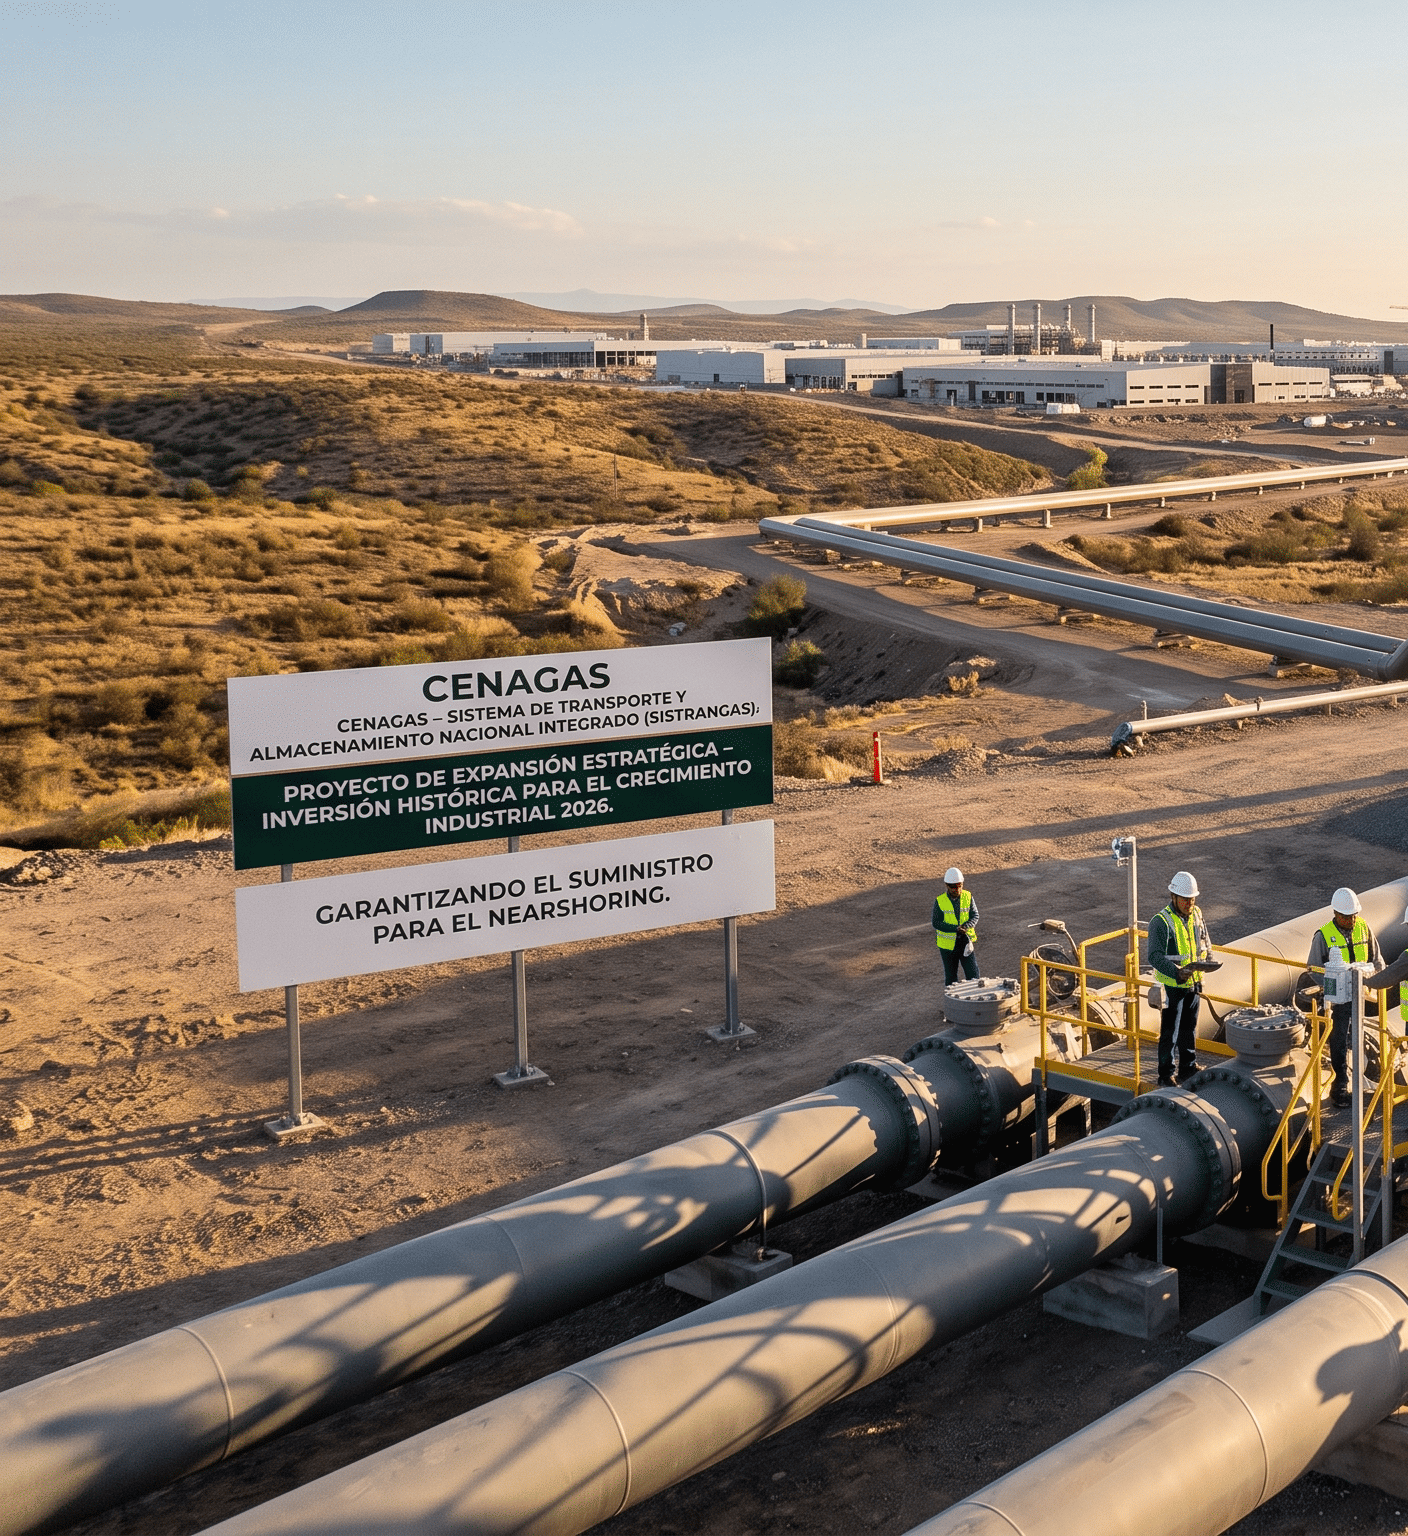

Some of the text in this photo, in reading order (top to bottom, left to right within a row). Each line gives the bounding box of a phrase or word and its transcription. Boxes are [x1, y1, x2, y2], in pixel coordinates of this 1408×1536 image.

[422, 662, 611, 703] CENAGAS
[249, 732, 435, 762] ALMACENAMIENTO
[439, 722, 535, 745] NACIONAL
[538, 712, 640, 735] INTEGRADO
[337, 712, 429, 733] CENAGAS
[447, 704, 526, 724] SISTEMA
[530, 701, 554, 716] DE
[557, 691, 672, 714] TRANSPORTE
[675, 690, 687, 703] Y
[262, 759, 752, 830] INVERSIÓN HISTÓRICA PARA EL CRECIMIENTO
[284, 774, 409, 803] PROYECTO
[415, 769, 447, 789] DE
[452, 753, 576, 785] EXPANSIÓN
[582, 741, 719, 771] ESTRATÉGICA
[425, 797, 614, 835] INDUSTRIAL 2026.
[315, 853, 714, 925] GARANTIZANDO EL SUMINISTRO
[373, 885, 671, 945] PARA EL NEARSHORING.
